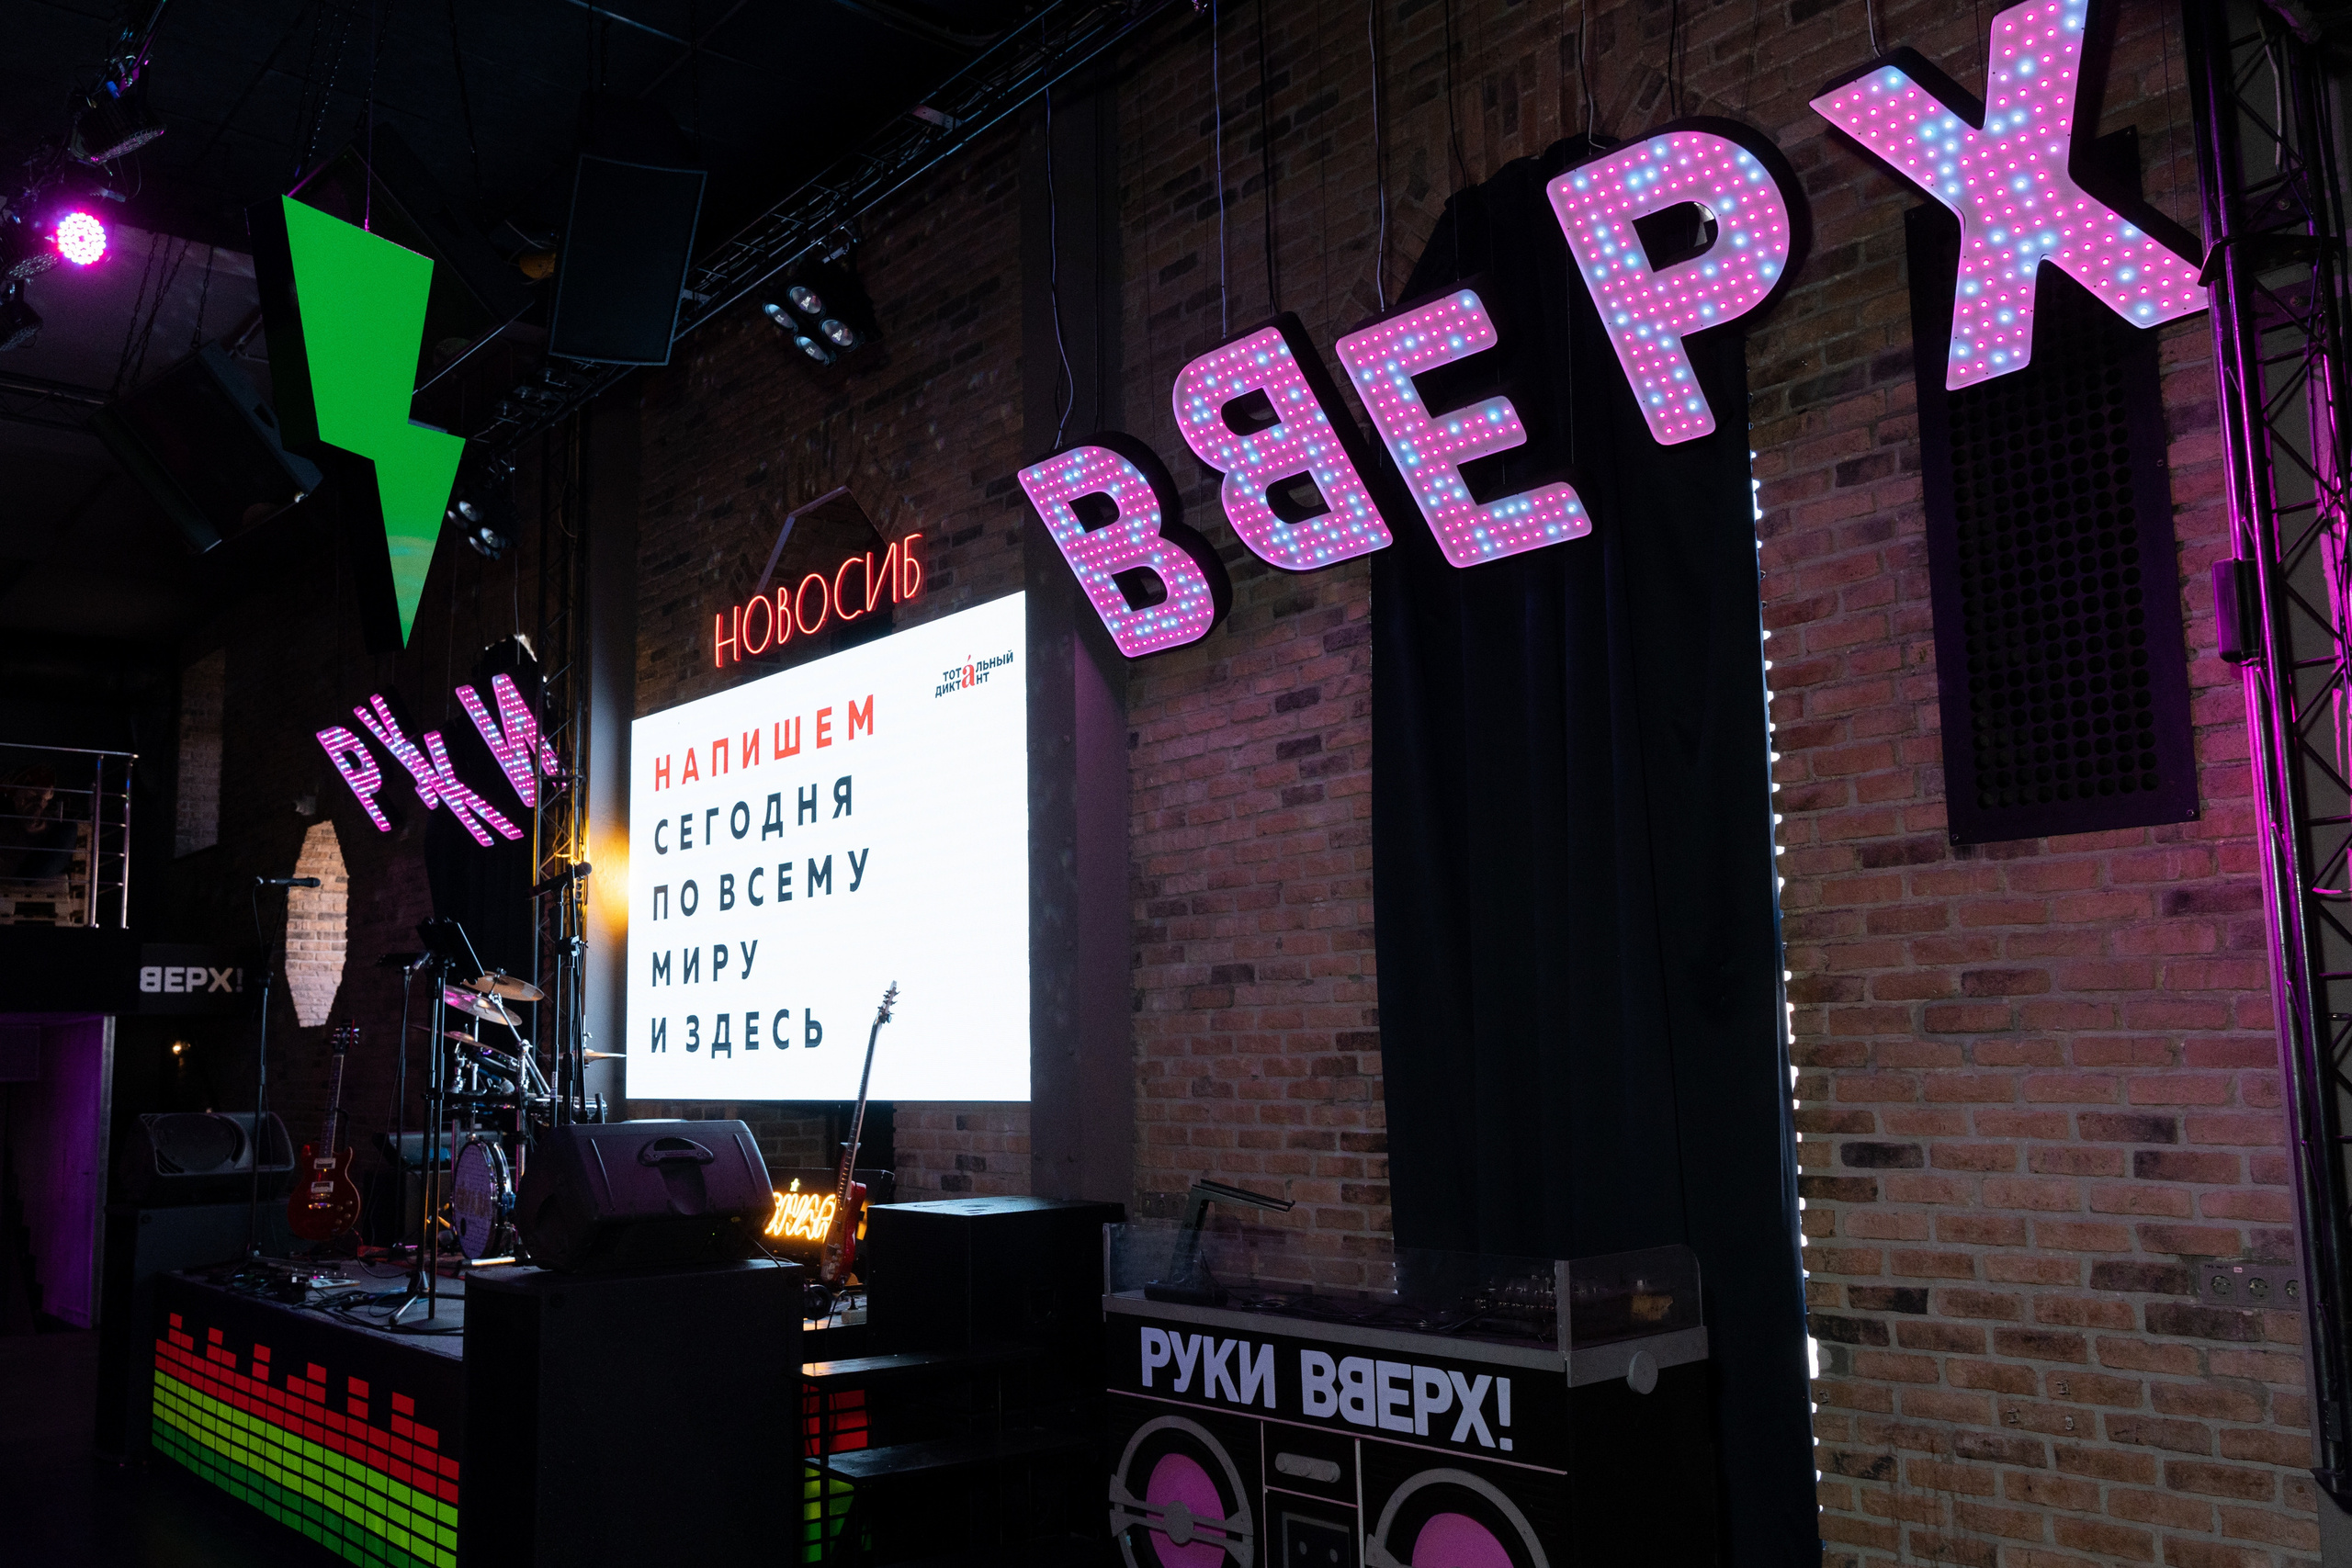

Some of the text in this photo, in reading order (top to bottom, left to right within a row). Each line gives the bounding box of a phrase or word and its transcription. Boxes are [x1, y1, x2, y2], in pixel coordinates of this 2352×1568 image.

[1017, 0, 2211, 659] ВВЕРХ
[715, 534, 922, 668] НОВОСИБ
[316, 673, 570, 847] РУКИ
[656, 694, 875, 792] НАПИШЕМ
[654, 774, 853, 855] СЕГОДНЯ
[652, 847, 870, 921] ПО ВСЕМУ
[651, 939, 759, 987] МИРУ
[650, 1008, 823, 1060] И ЗДЕСЬ
[1140, 1326, 1514, 1451] РУКИ ВВЕРХ!
